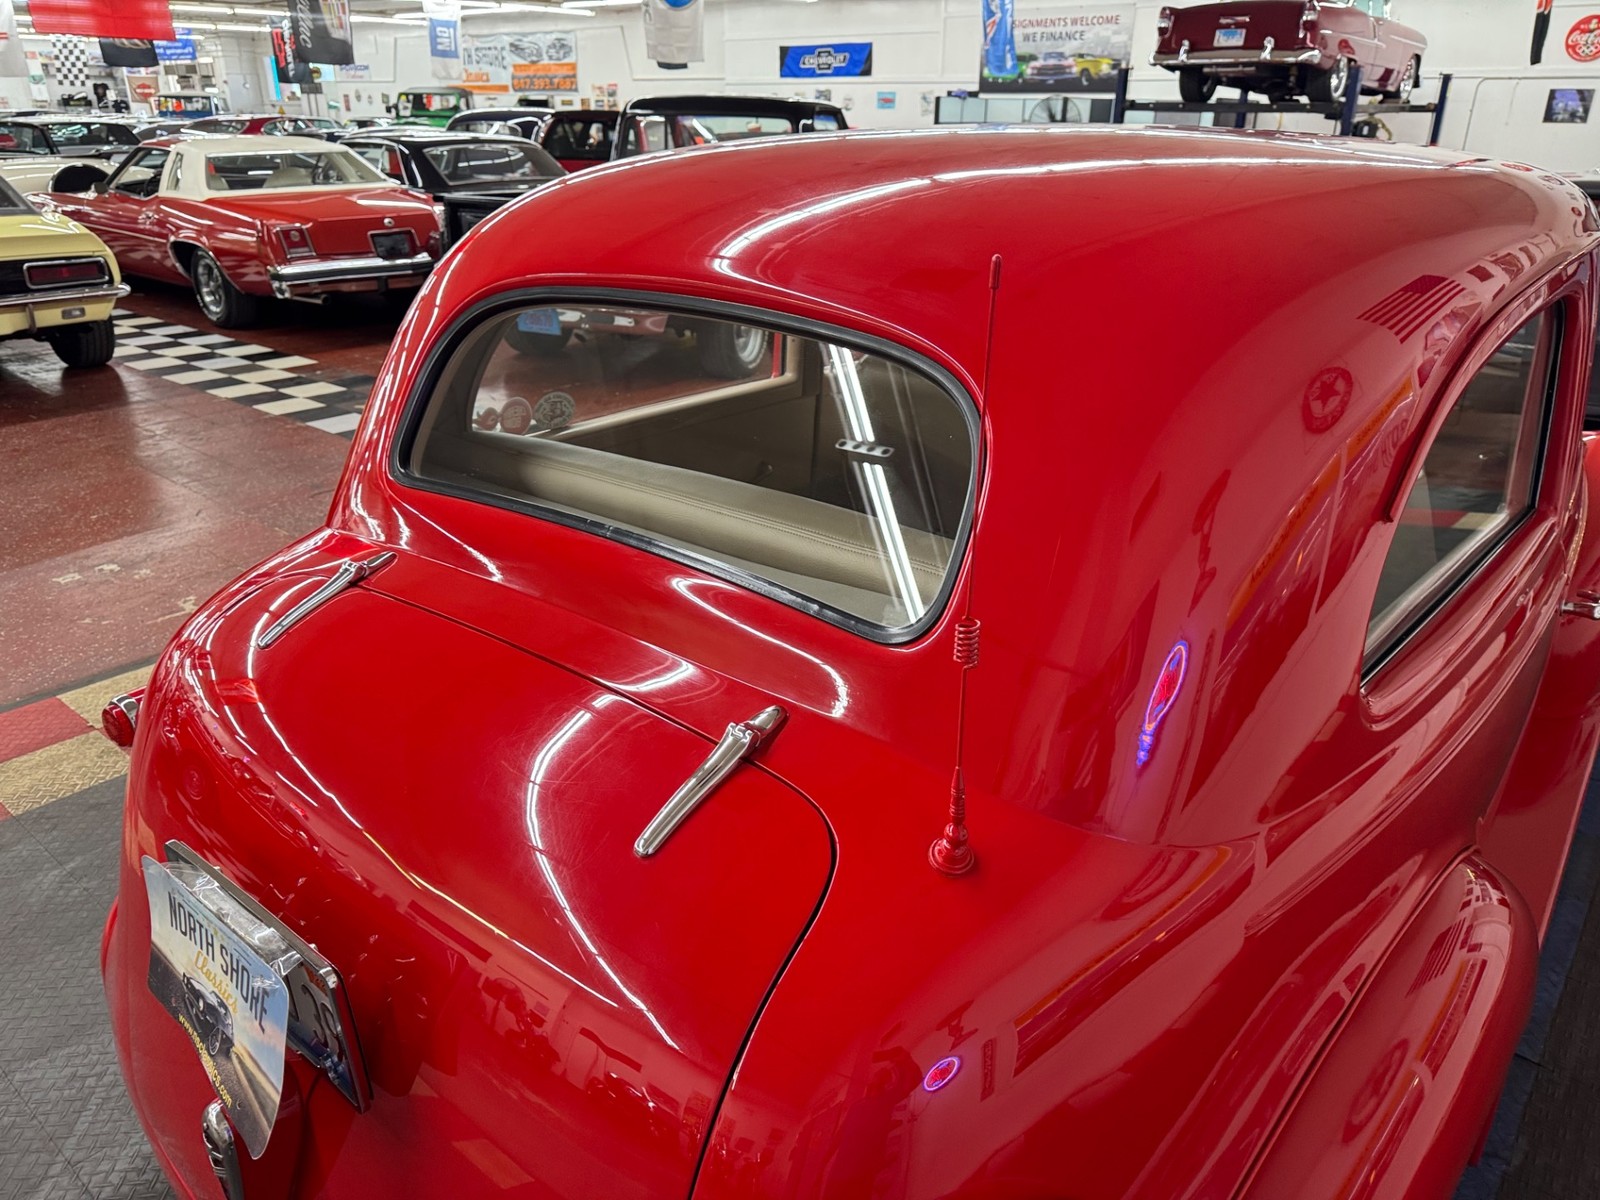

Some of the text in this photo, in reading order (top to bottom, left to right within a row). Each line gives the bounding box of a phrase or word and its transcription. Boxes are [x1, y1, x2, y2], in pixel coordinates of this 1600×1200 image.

[1022, 30, 1085, 43] WE FINANCE
[1070, 14, 1121, 27] WELCOME
[168, 890, 270, 1034] NORTH SHORE
[194, 949, 238, 1014] Classics
